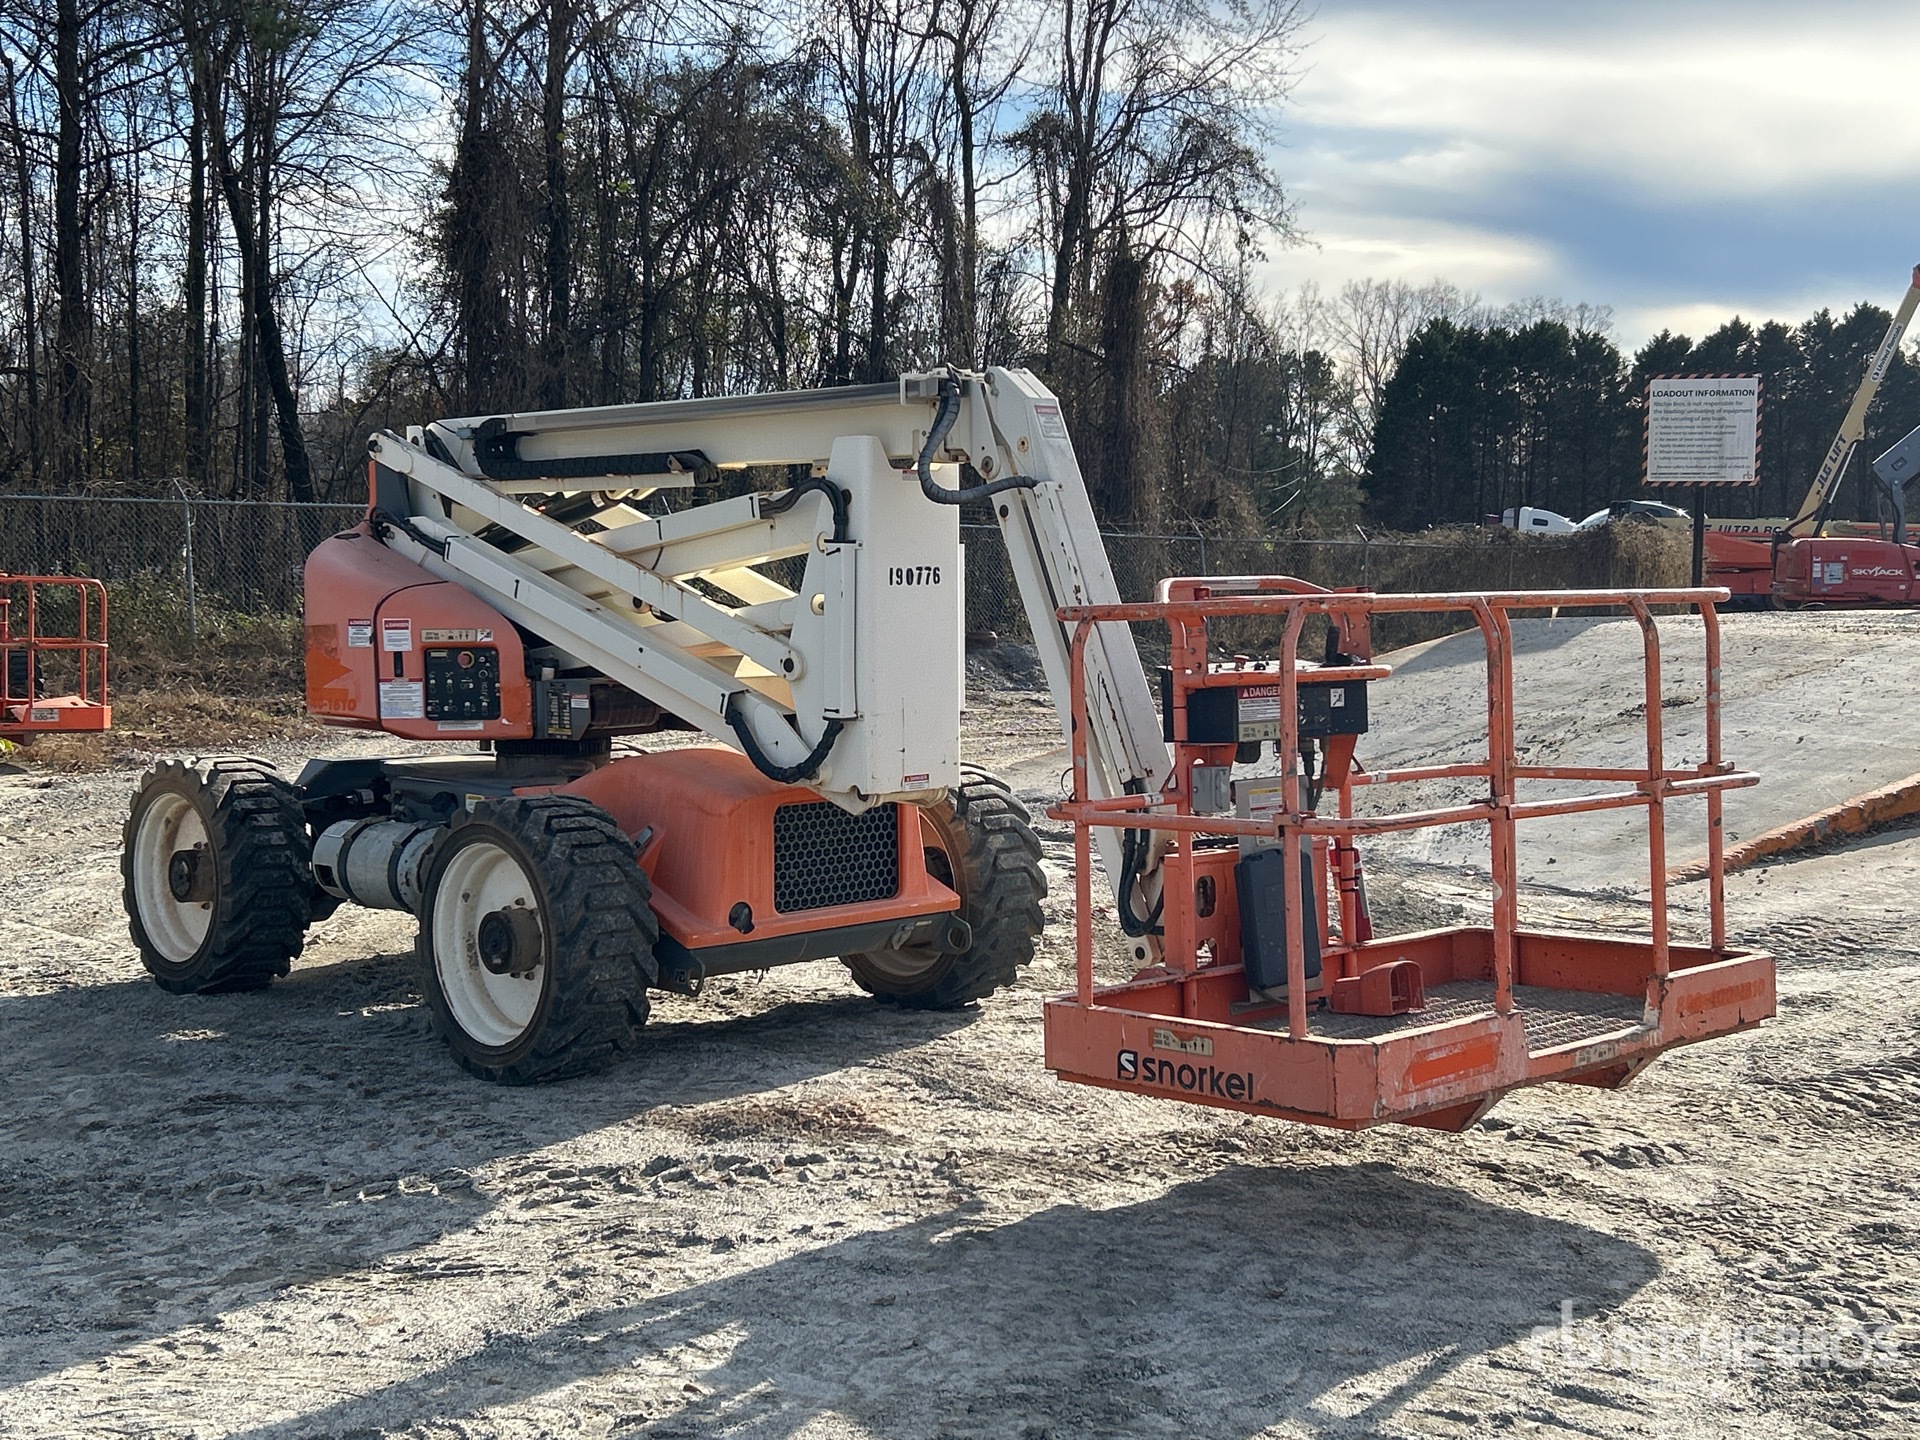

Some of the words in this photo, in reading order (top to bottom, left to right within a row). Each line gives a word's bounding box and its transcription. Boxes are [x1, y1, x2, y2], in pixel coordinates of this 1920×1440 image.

[1876, 350, 1891, 373] United
[1888, 325, 1902, 350] Rentals
[1695, 389, 1755, 397] INFORMATION
[1816, 464, 1833, 490] JLG
[1829, 434, 1848, 465] LIFT
[1718, 524, 1757, 534] ULTRA
[889, 566, 941, 586] 190776
[1852, 566, 1904, 577] SKYJACK
[1142, 1056, 1254, 1101] snorkel
